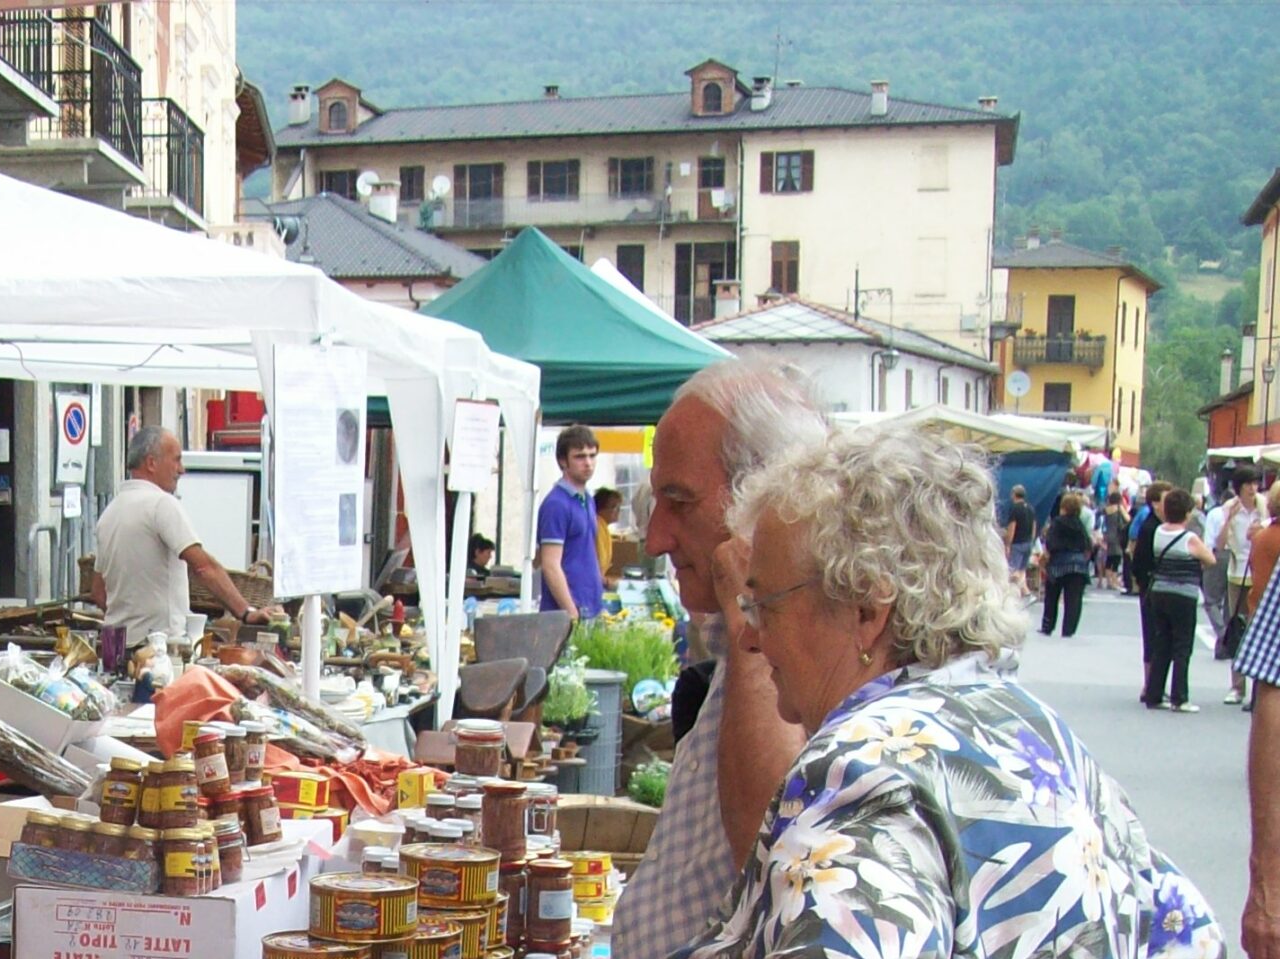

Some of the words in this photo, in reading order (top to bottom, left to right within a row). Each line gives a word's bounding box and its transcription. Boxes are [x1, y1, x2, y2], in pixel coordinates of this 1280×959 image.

[173, 911, 191, 926] N.
[79, 932, 118, 949] TIPO
[144, 936, 191, 953] LATTE
